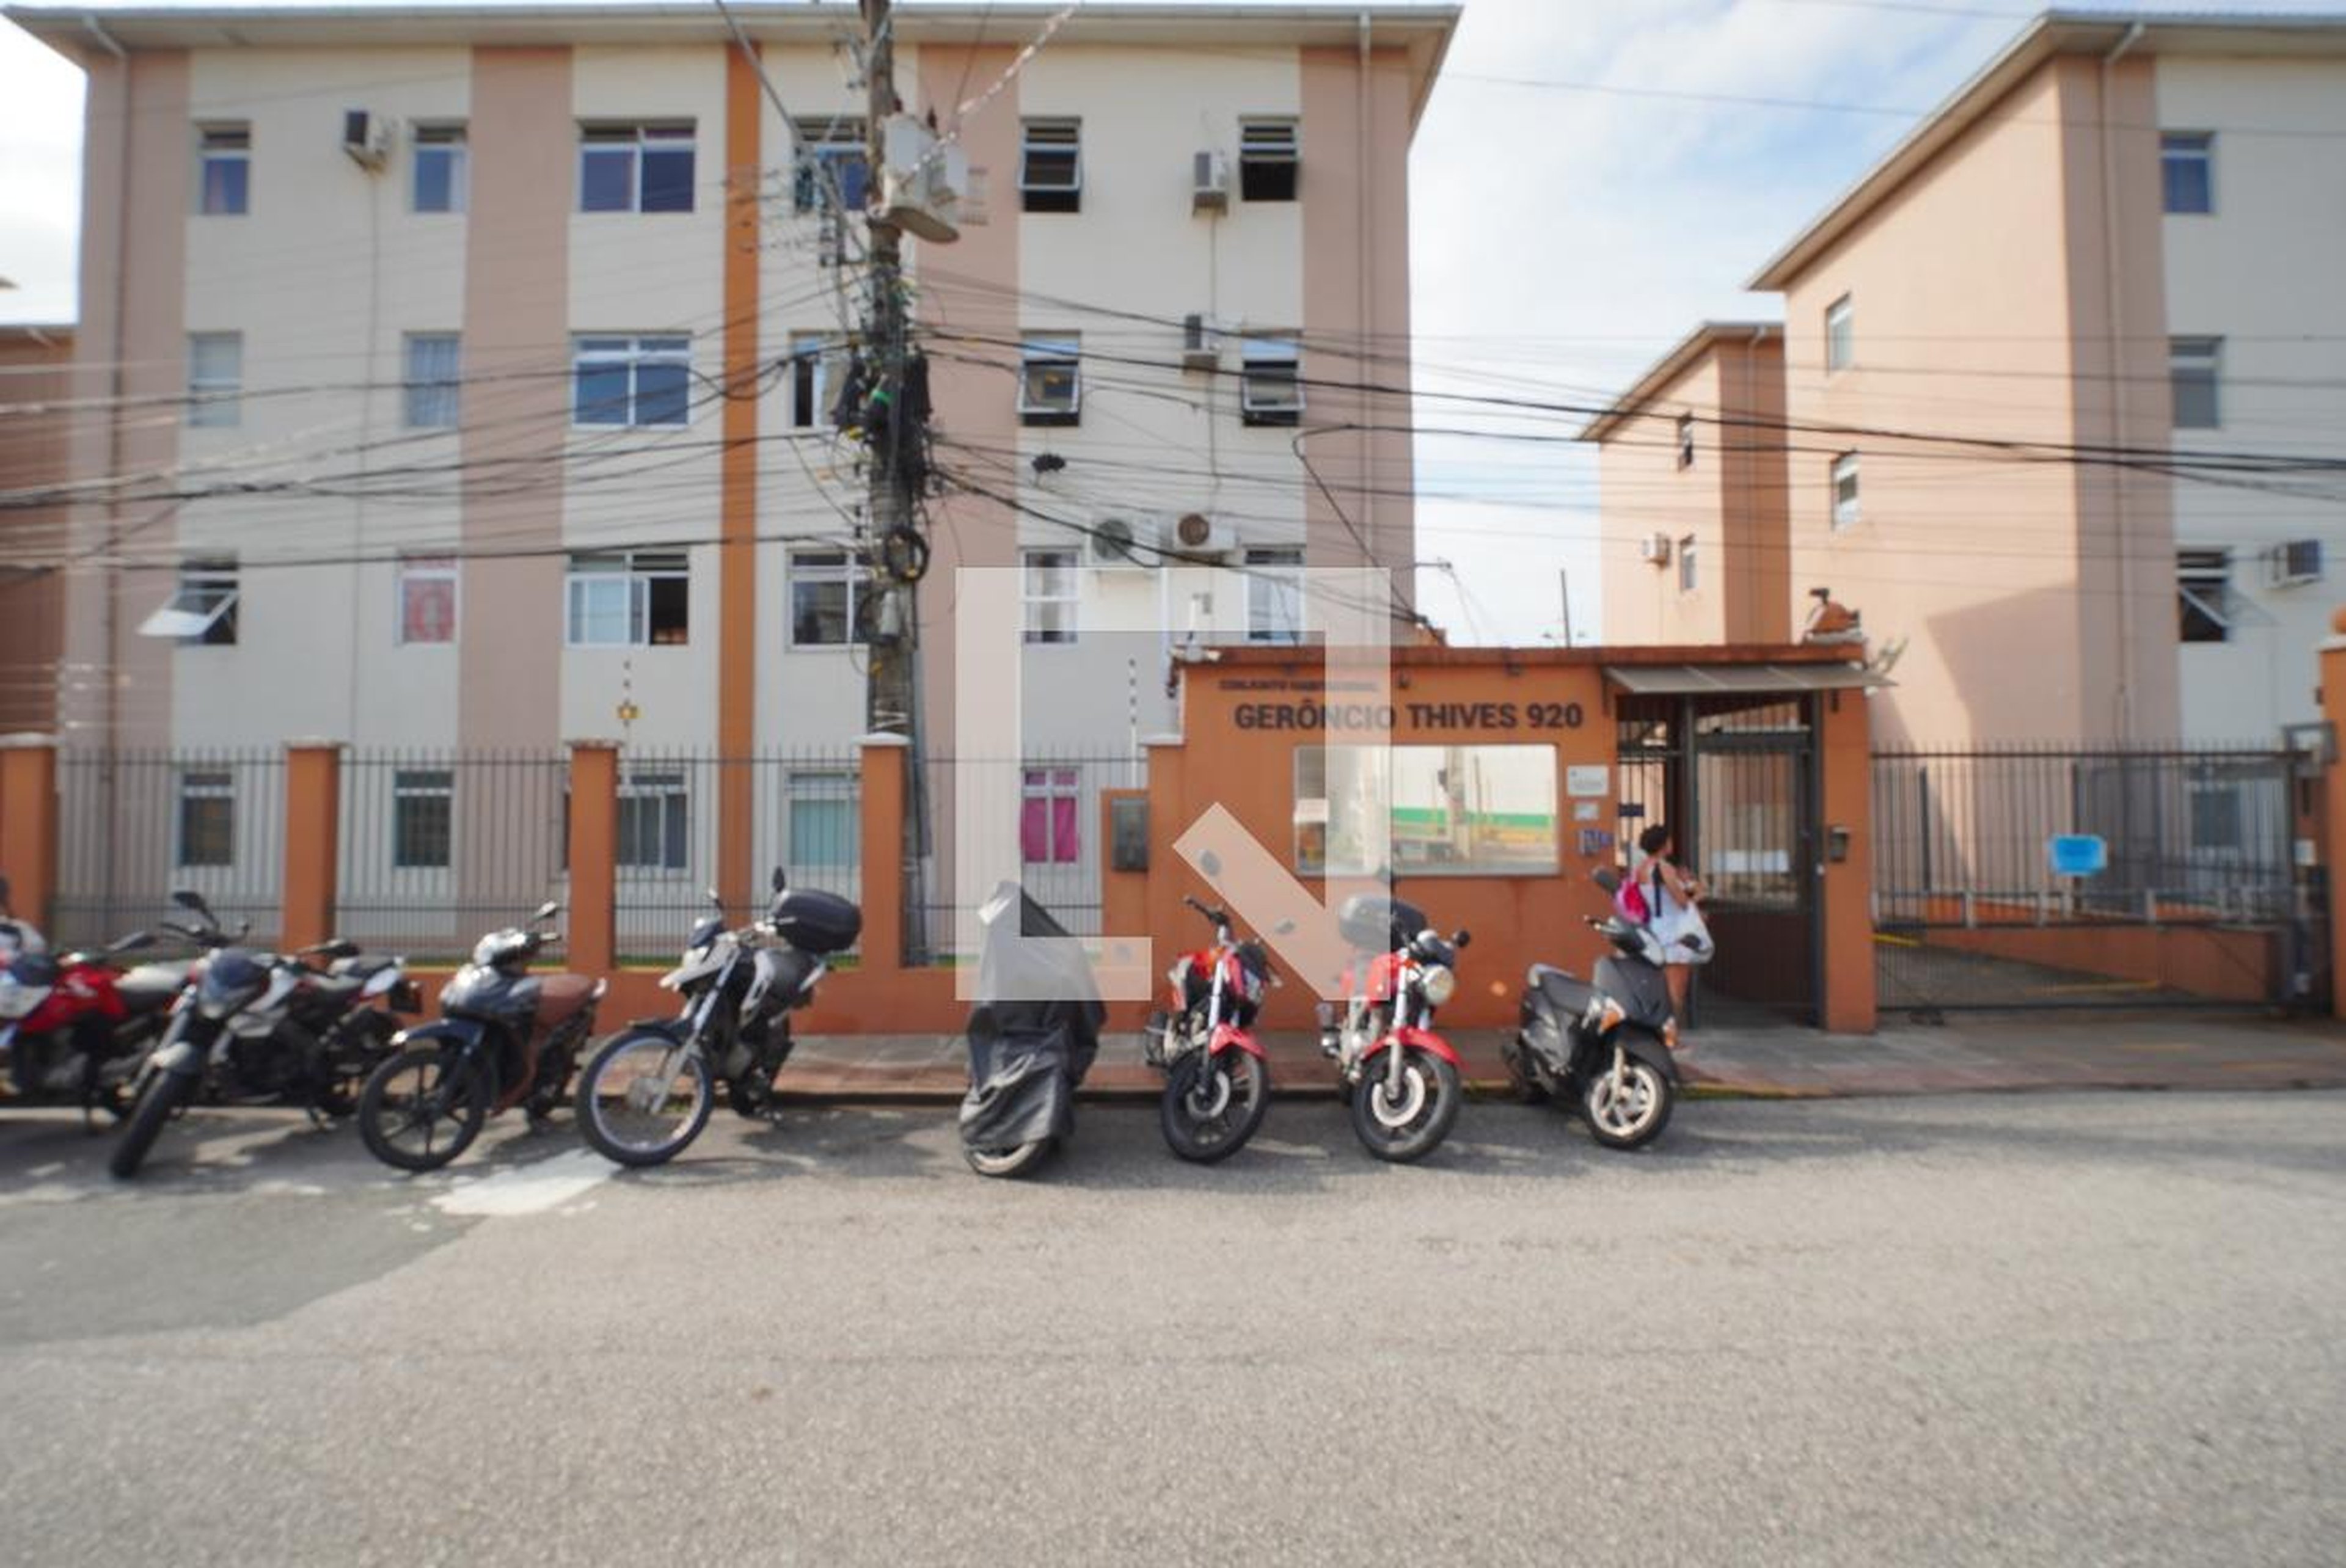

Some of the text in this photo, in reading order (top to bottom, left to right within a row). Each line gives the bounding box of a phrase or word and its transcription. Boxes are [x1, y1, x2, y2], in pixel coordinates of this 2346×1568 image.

[1234, 698, 1584, 729] GERÔNCIO THIVES 920
